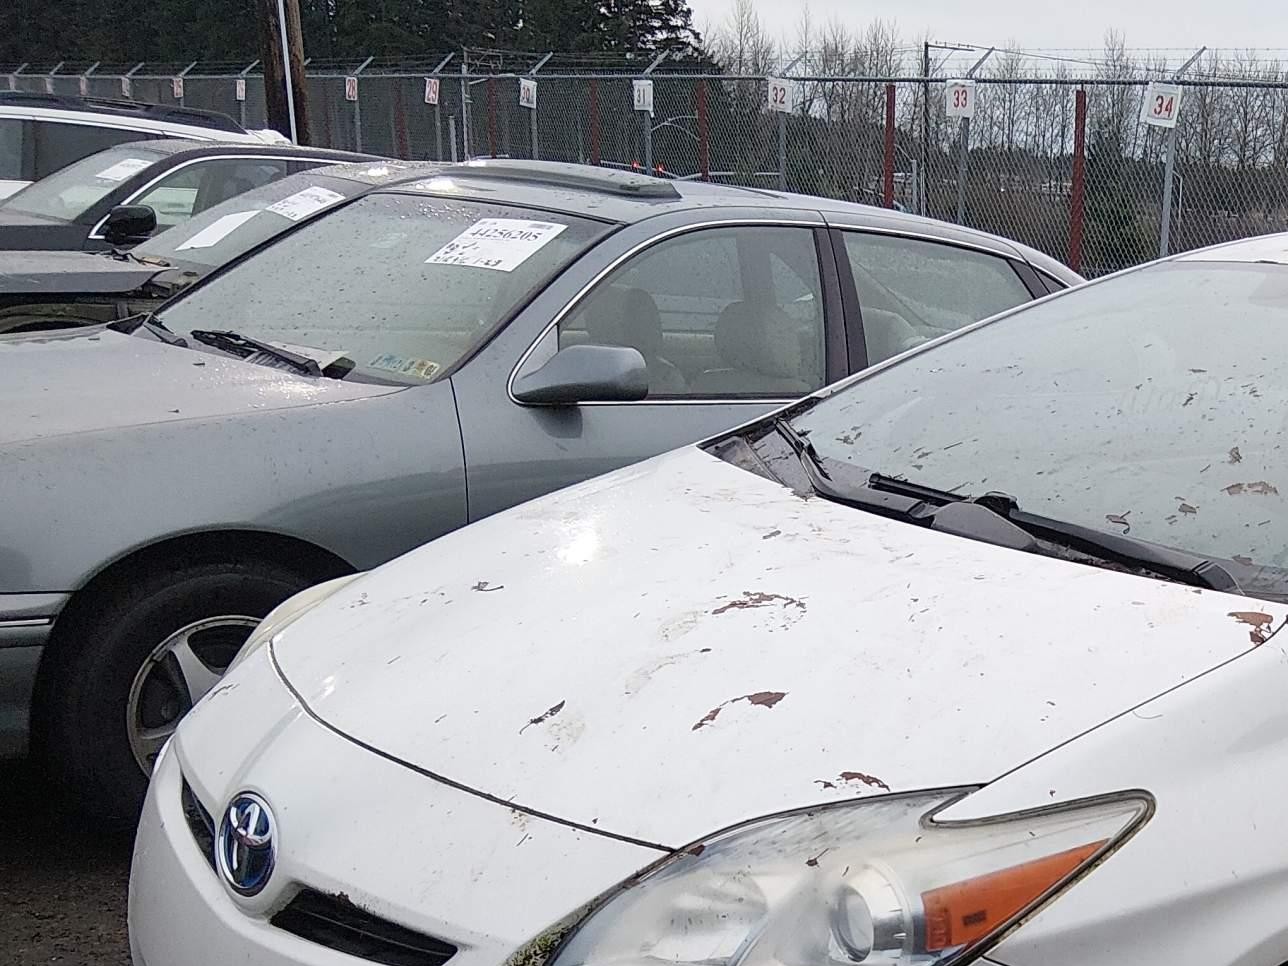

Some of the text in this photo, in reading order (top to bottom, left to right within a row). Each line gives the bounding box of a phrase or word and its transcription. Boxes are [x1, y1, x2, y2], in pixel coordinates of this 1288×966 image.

[346, 78, 356, 99] 28
[427, 78, 438, 104] 29
[771, 86, 786, 105] 32
[953, 89, 968, 108] 33
[1154, 94, 1174, 118] 34
